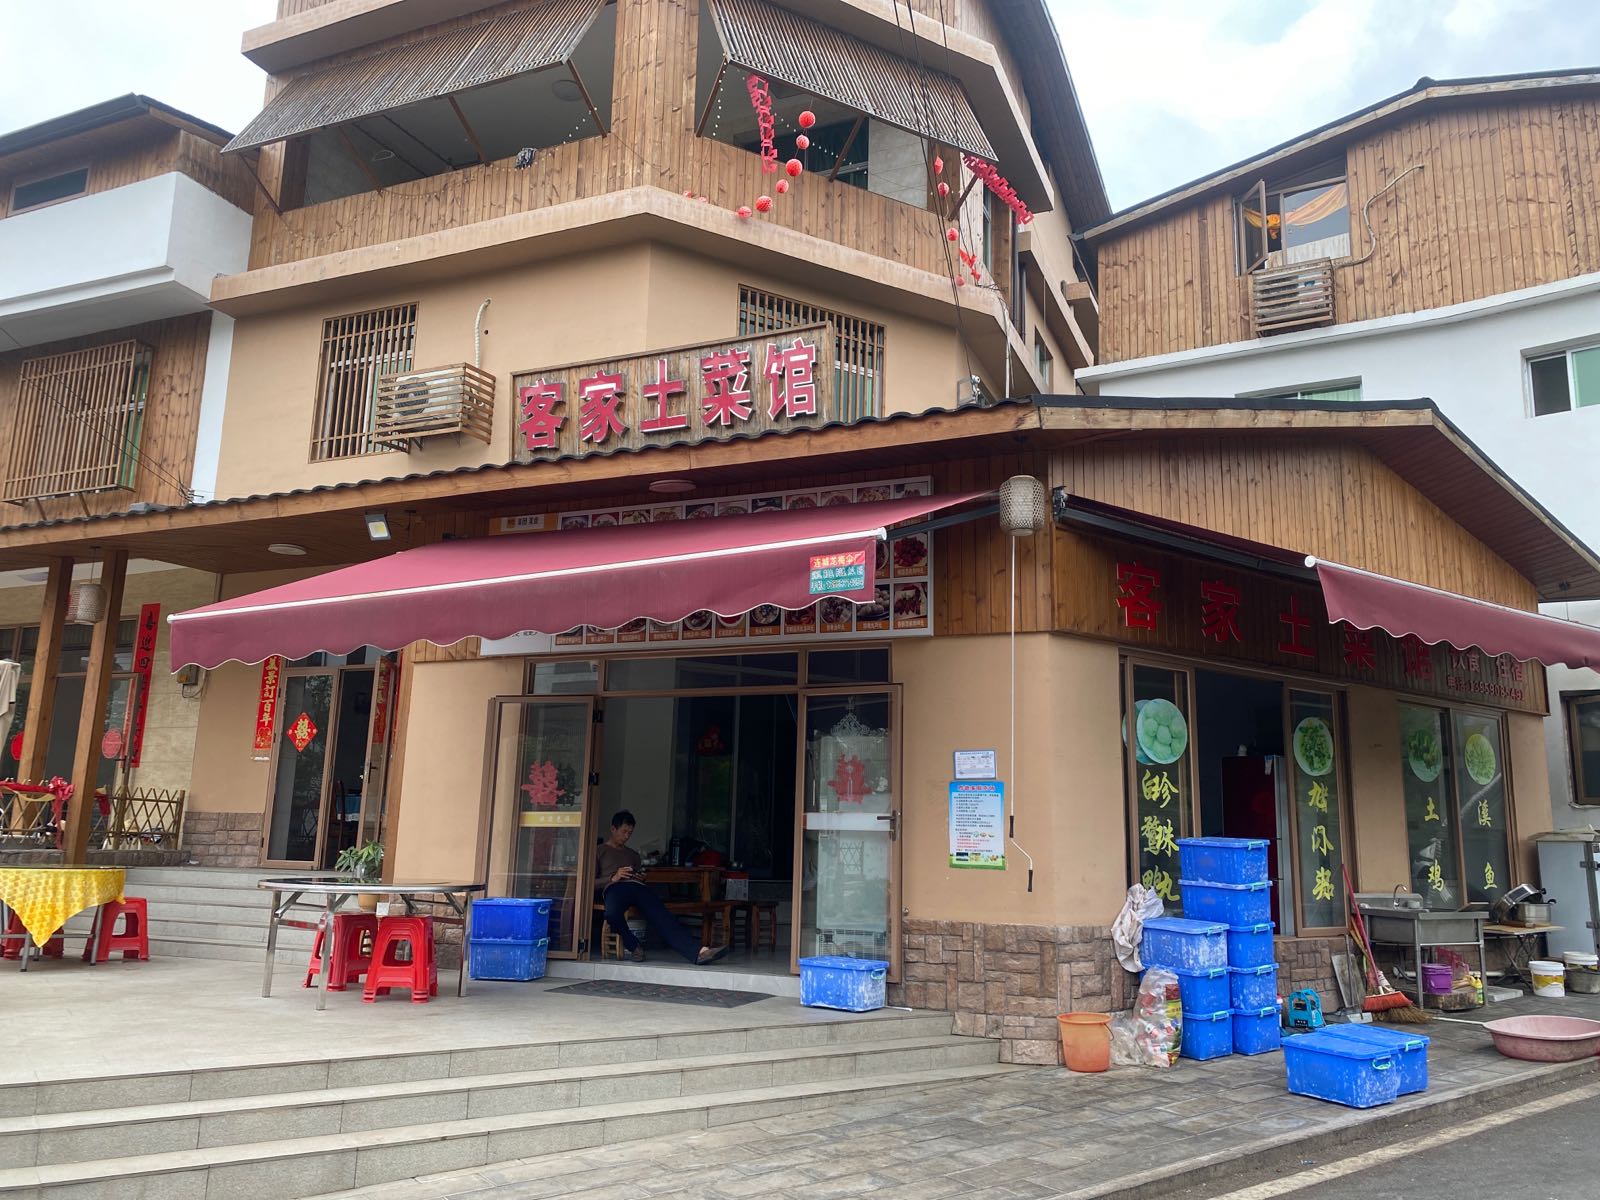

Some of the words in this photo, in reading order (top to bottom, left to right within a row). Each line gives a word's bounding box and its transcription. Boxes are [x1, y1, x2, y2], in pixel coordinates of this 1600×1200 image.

[519, 337, 817, 451] 客家土菜馆
[1424, 796, 1444, 891] 土鸡
[1478, 799, 1498, 890] 溪鱼
